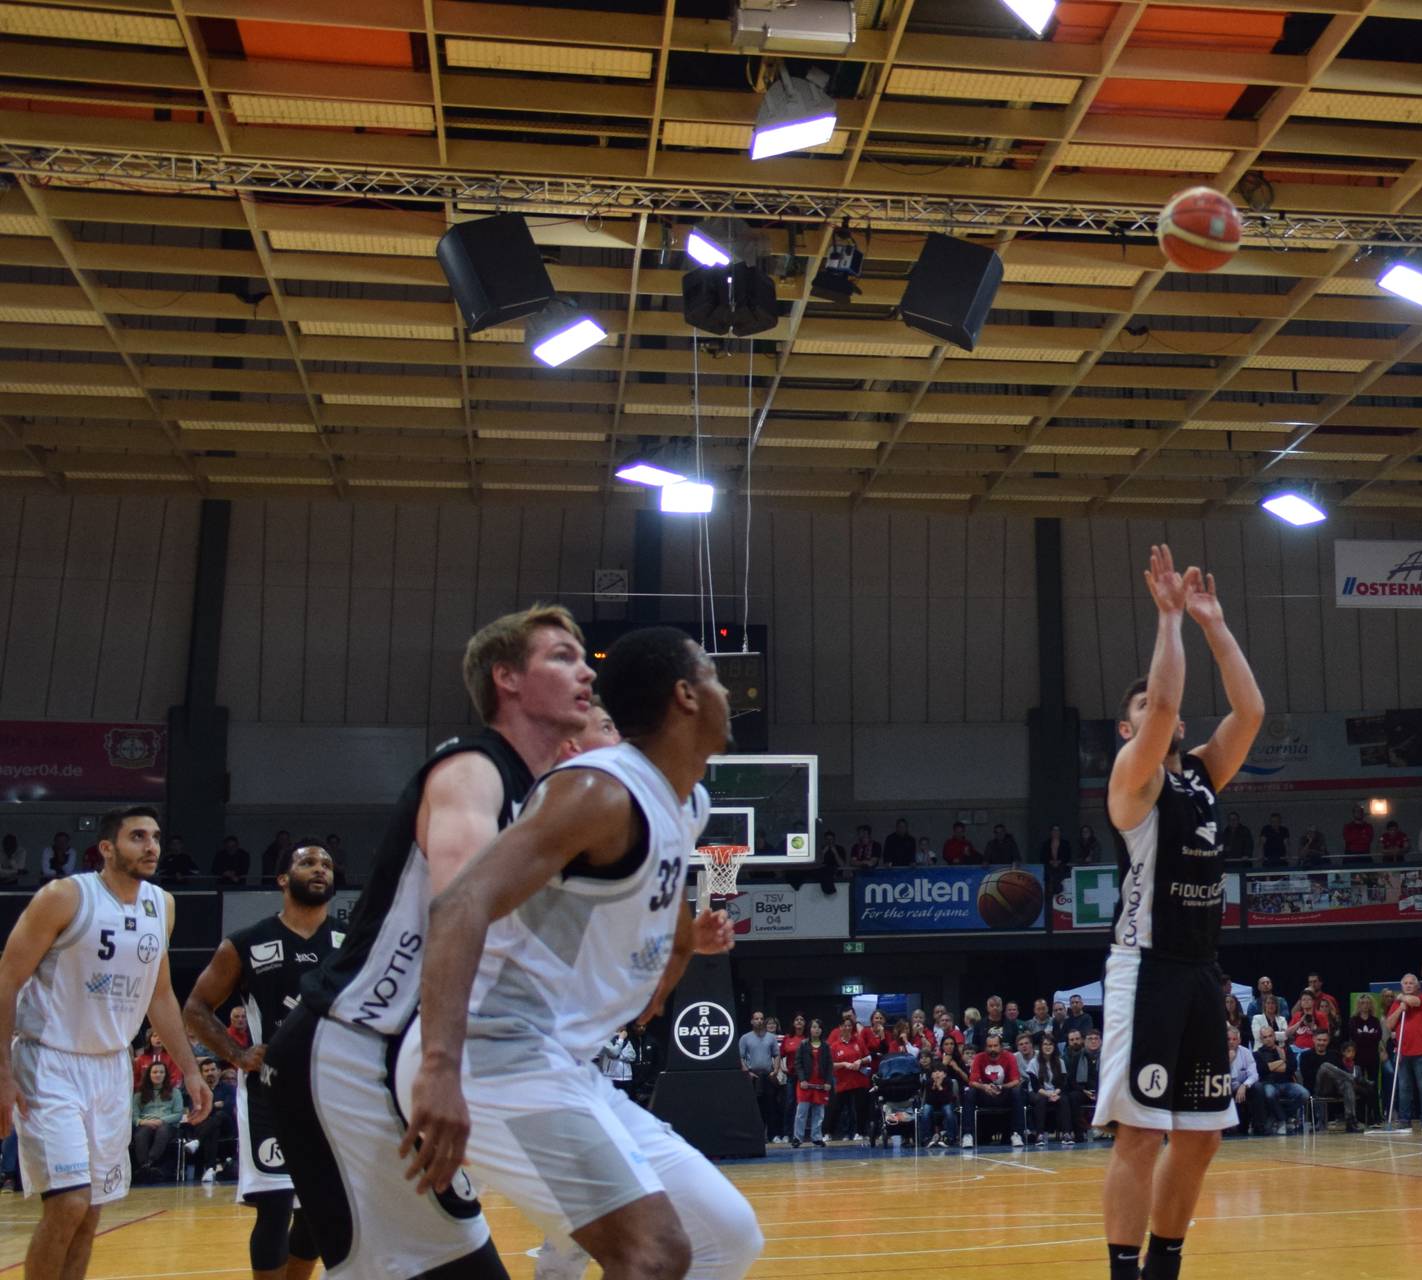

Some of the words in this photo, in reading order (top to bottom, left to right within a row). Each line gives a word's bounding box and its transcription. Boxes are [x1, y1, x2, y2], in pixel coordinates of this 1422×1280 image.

[0, 764, 82, 778] ayer04.de
[764, 894, 784, 902] TSV
[864, 879, 969, 903] molten
[755, 902, 793, 914] Bayer
[861, 907, 883, 920] For
[884, 907, 905, 919] the
[906, 906, 931, 919] real
[934, 909, 969, 921] game
[766, 915, 781, 924] 04
[98, 929, 115, 960] 5
[679, 1026, 730, 1037] BAYER
[699, 1006, 710, 1056] BAYER
